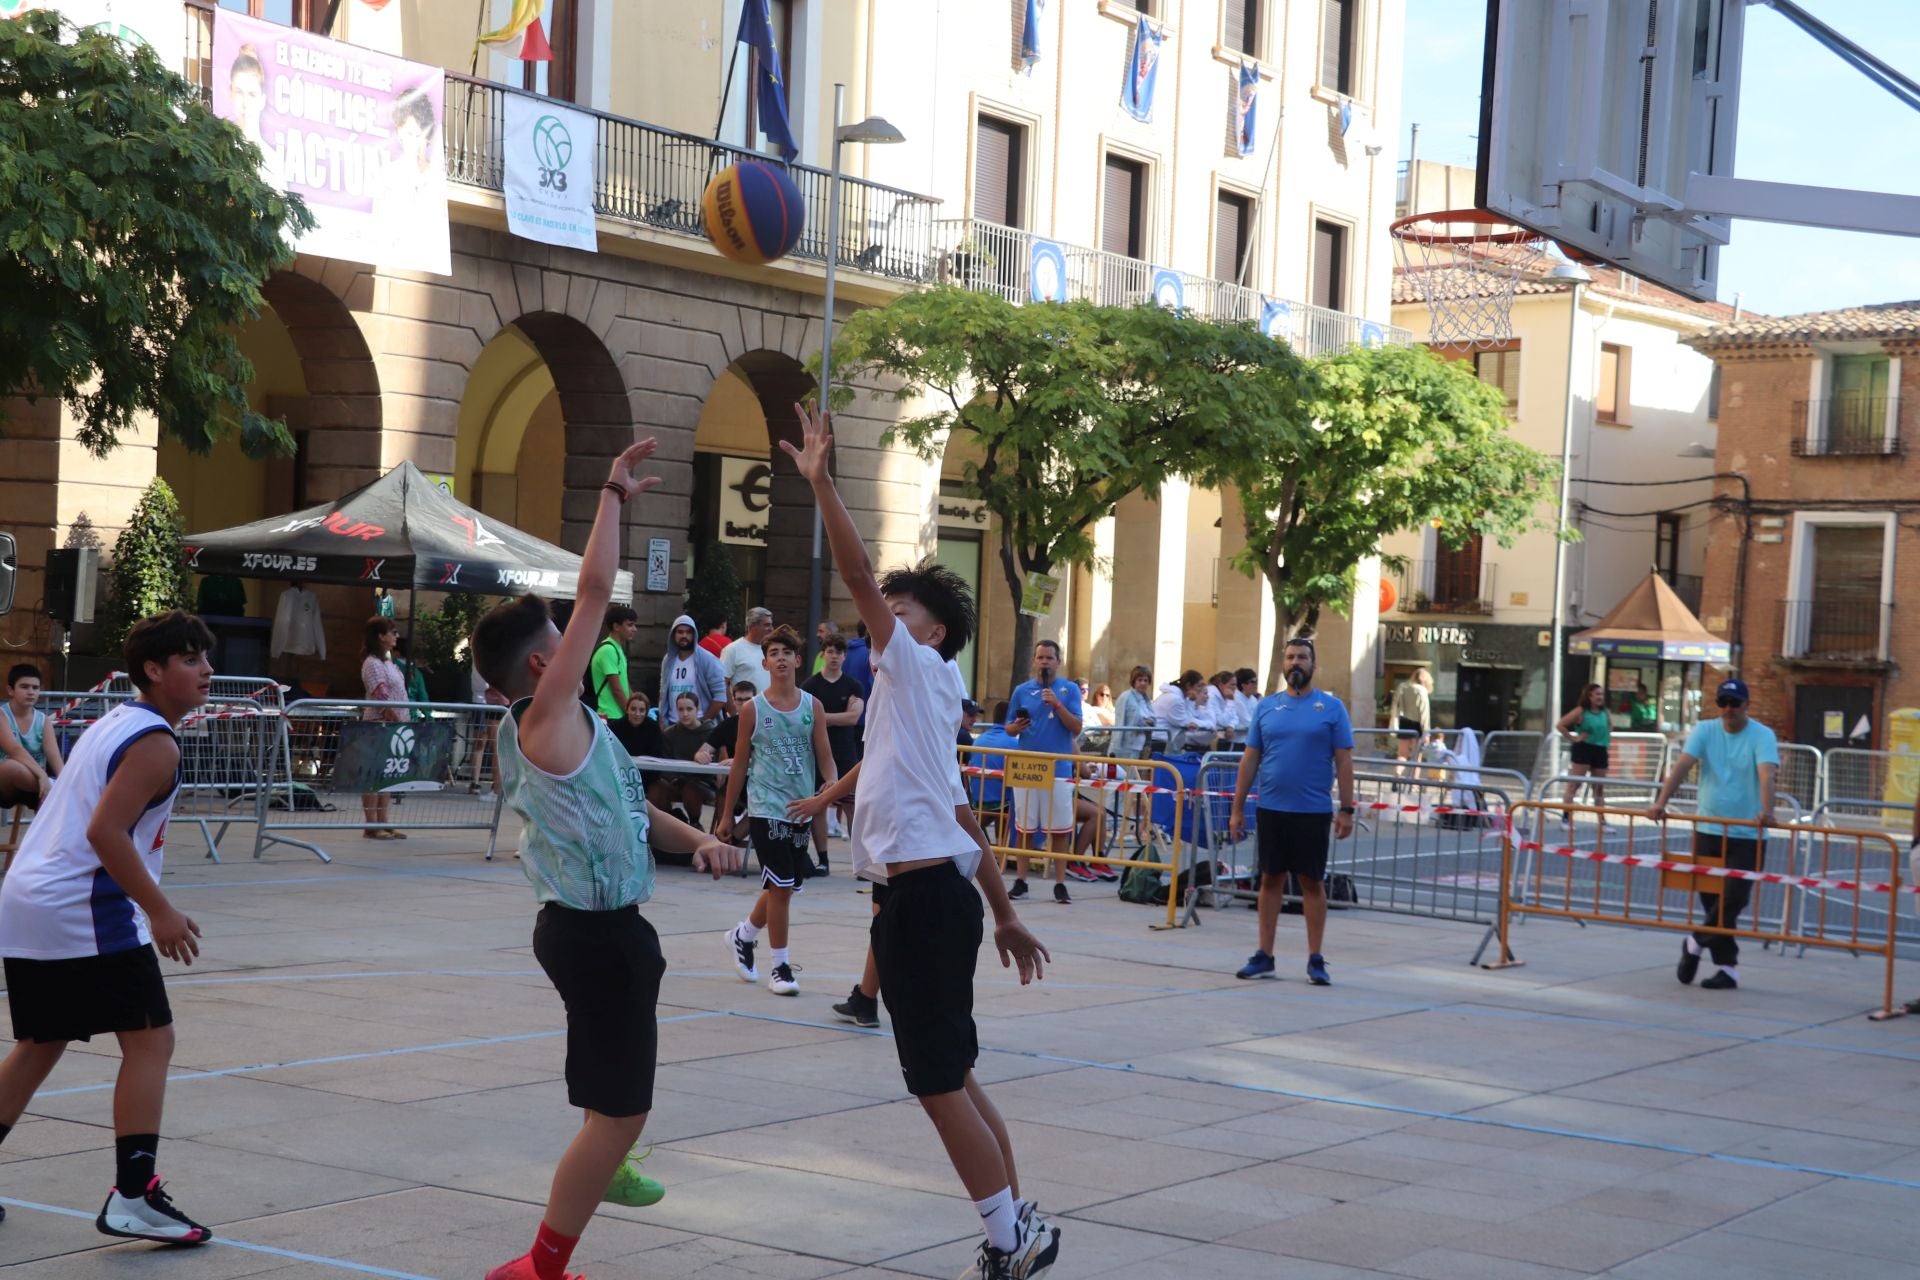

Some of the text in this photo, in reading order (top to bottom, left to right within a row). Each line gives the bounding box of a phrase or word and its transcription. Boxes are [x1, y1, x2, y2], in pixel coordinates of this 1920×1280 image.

[275, 40, 290, 66] EL
[290, 44, 346, 81] SILENCIO
[347, 58, 362, 86] TE
[716, 180, 746, 250] Wilson
[725, 520, 769, 543] iberCaj
[242, 553, 317, 572] XFOUR.ES
[497, 569, 560, 588] XFOUR.ES
[1386, 625, 1412, 643] OSE
[676, 667, 687, 680] 10
[383, 757, 410, 774] 3X3
[783, 757, 804, 775] 25
[1027, 763, 1048, 772] AYTO
[1012, 772, 1043, 782] ALFARO
